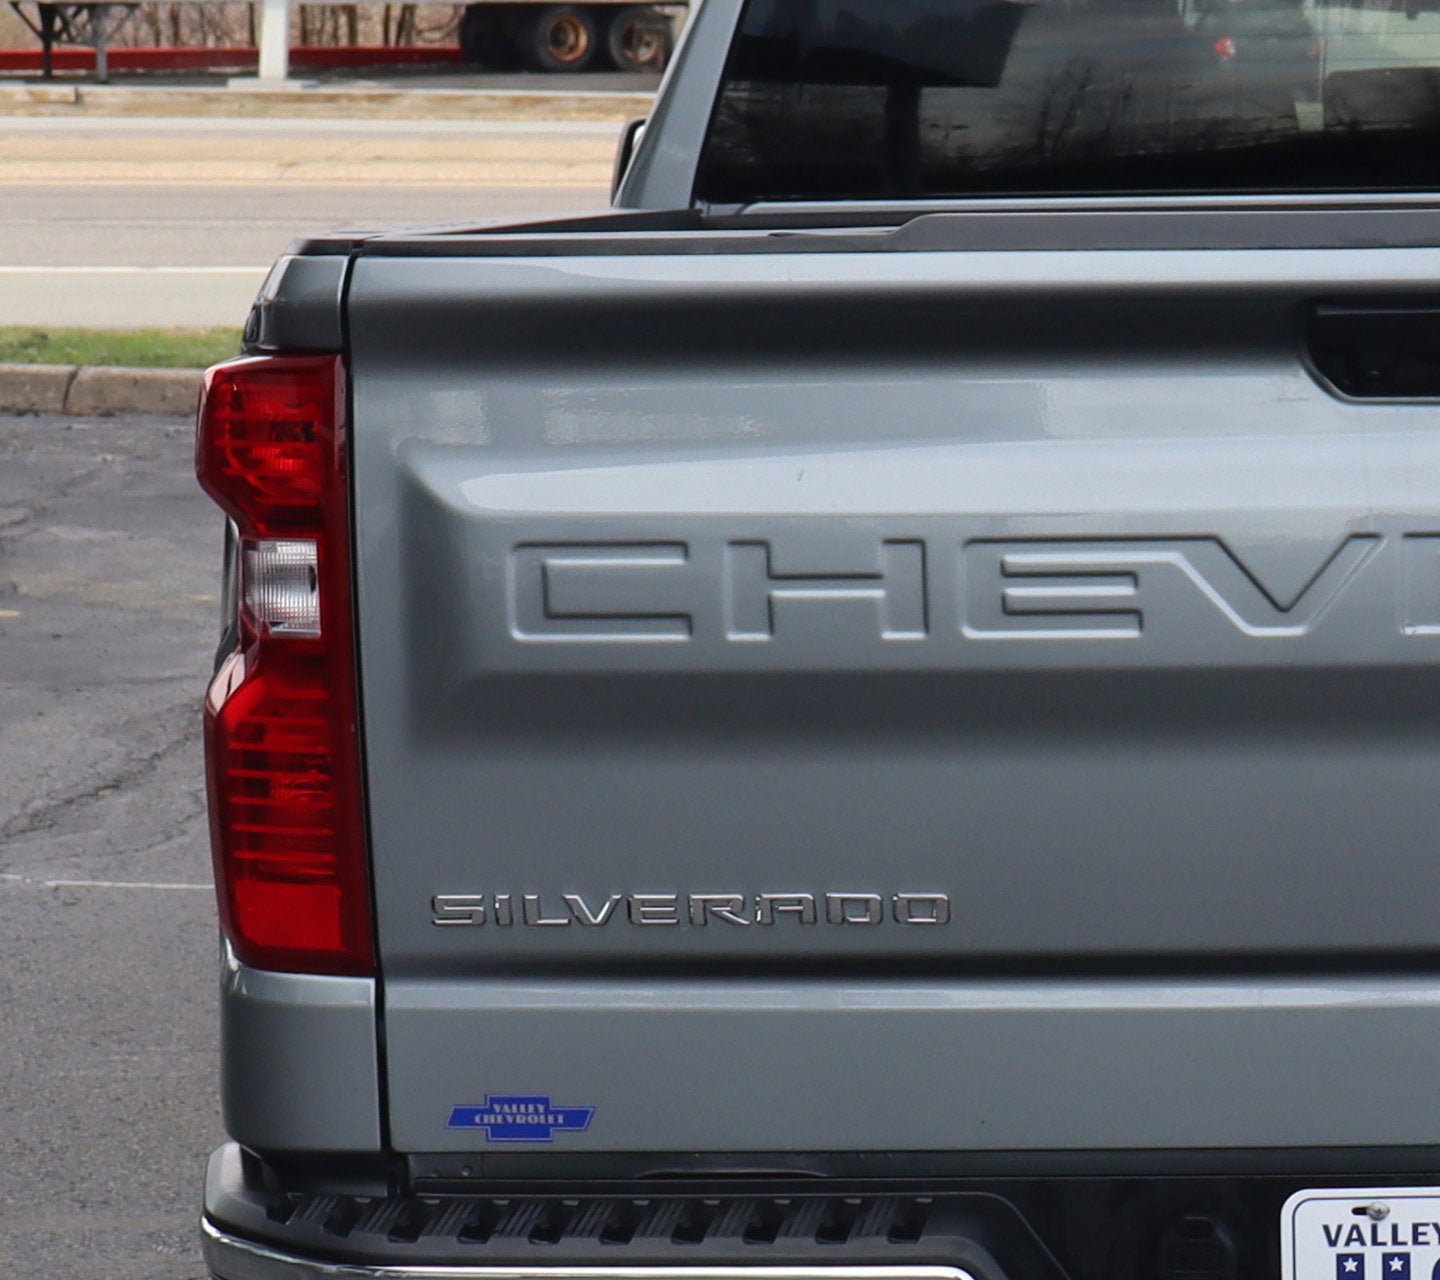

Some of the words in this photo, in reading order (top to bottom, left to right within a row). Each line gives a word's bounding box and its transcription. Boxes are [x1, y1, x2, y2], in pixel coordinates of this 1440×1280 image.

[430, 892, 952, 926] SILVERADO
[493, 1103, 547, 1113] VALLEY
[474, 1114, 564, 1124] CHEVROLET
